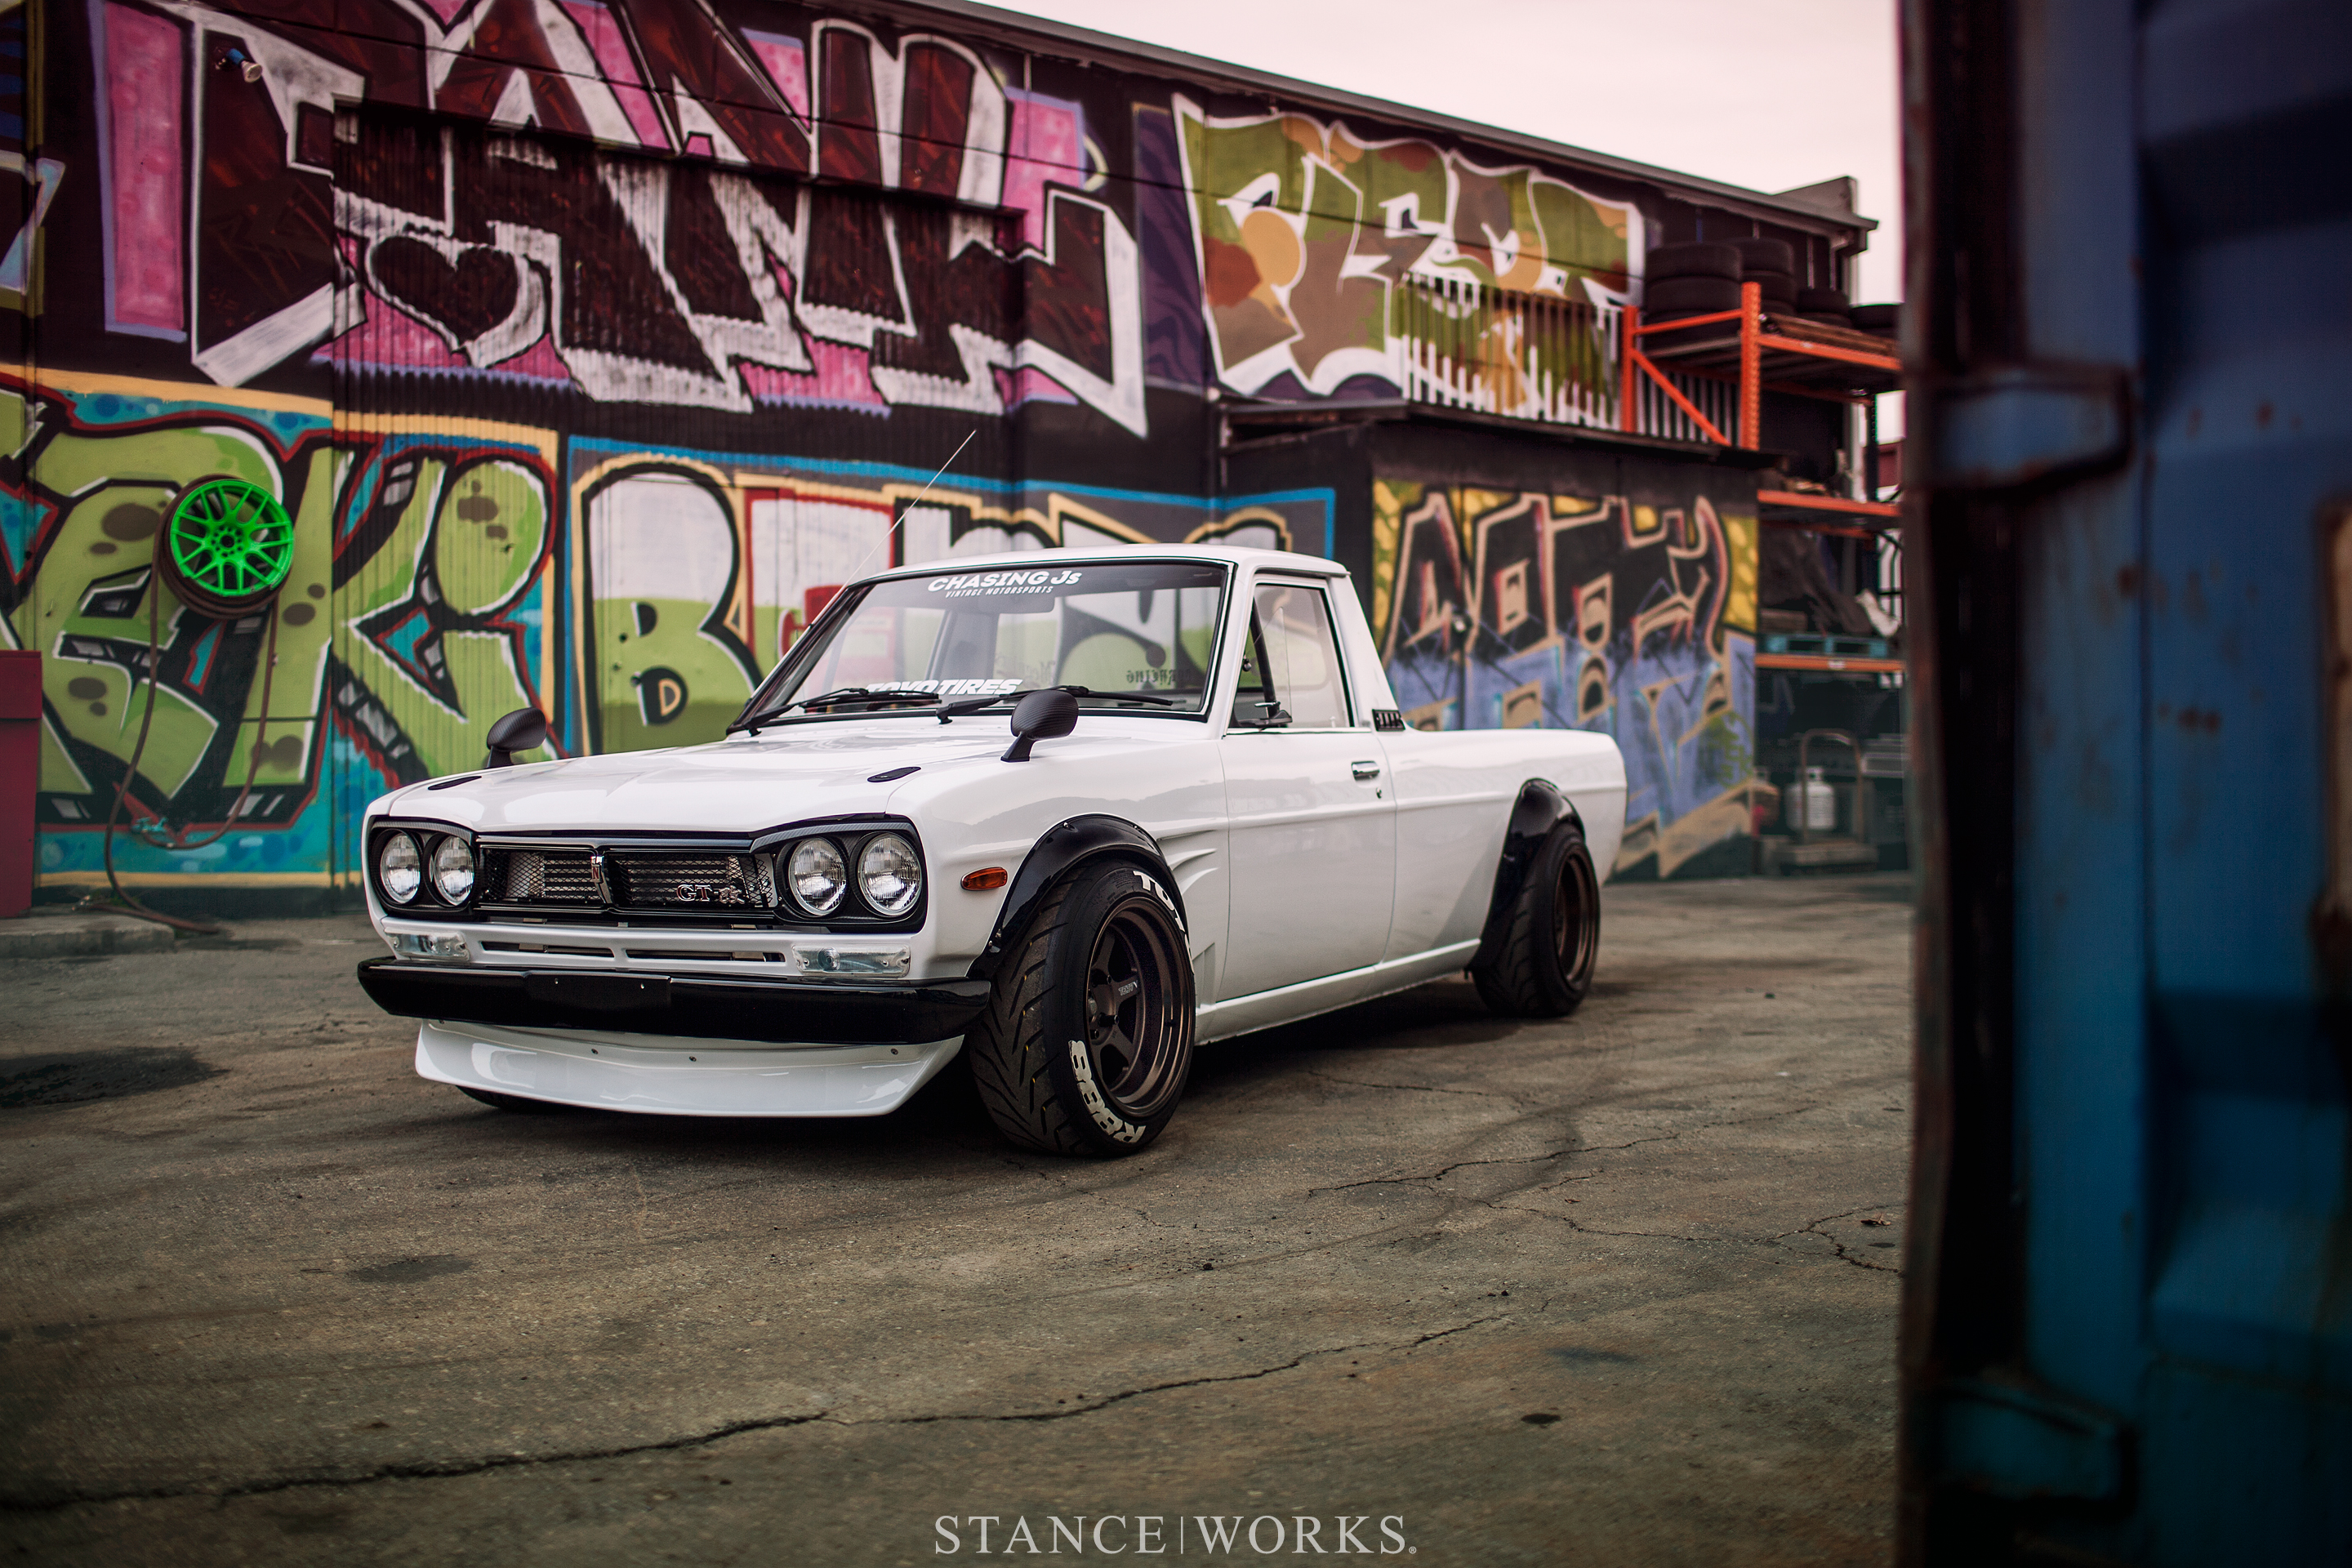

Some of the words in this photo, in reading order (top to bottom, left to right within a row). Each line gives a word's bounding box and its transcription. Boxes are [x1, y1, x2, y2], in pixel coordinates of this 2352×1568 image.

[928, 571, 1050, 592] CHASING
[1050, 571, 1082, 586] Js
[945, 588, 983, 599] VINTAGE
[985, 586, 1054, 596] MOTORSPORTS
[938, 679, 1022, 695] TIRES
[1068, 1040, 1147, 1143] R888
